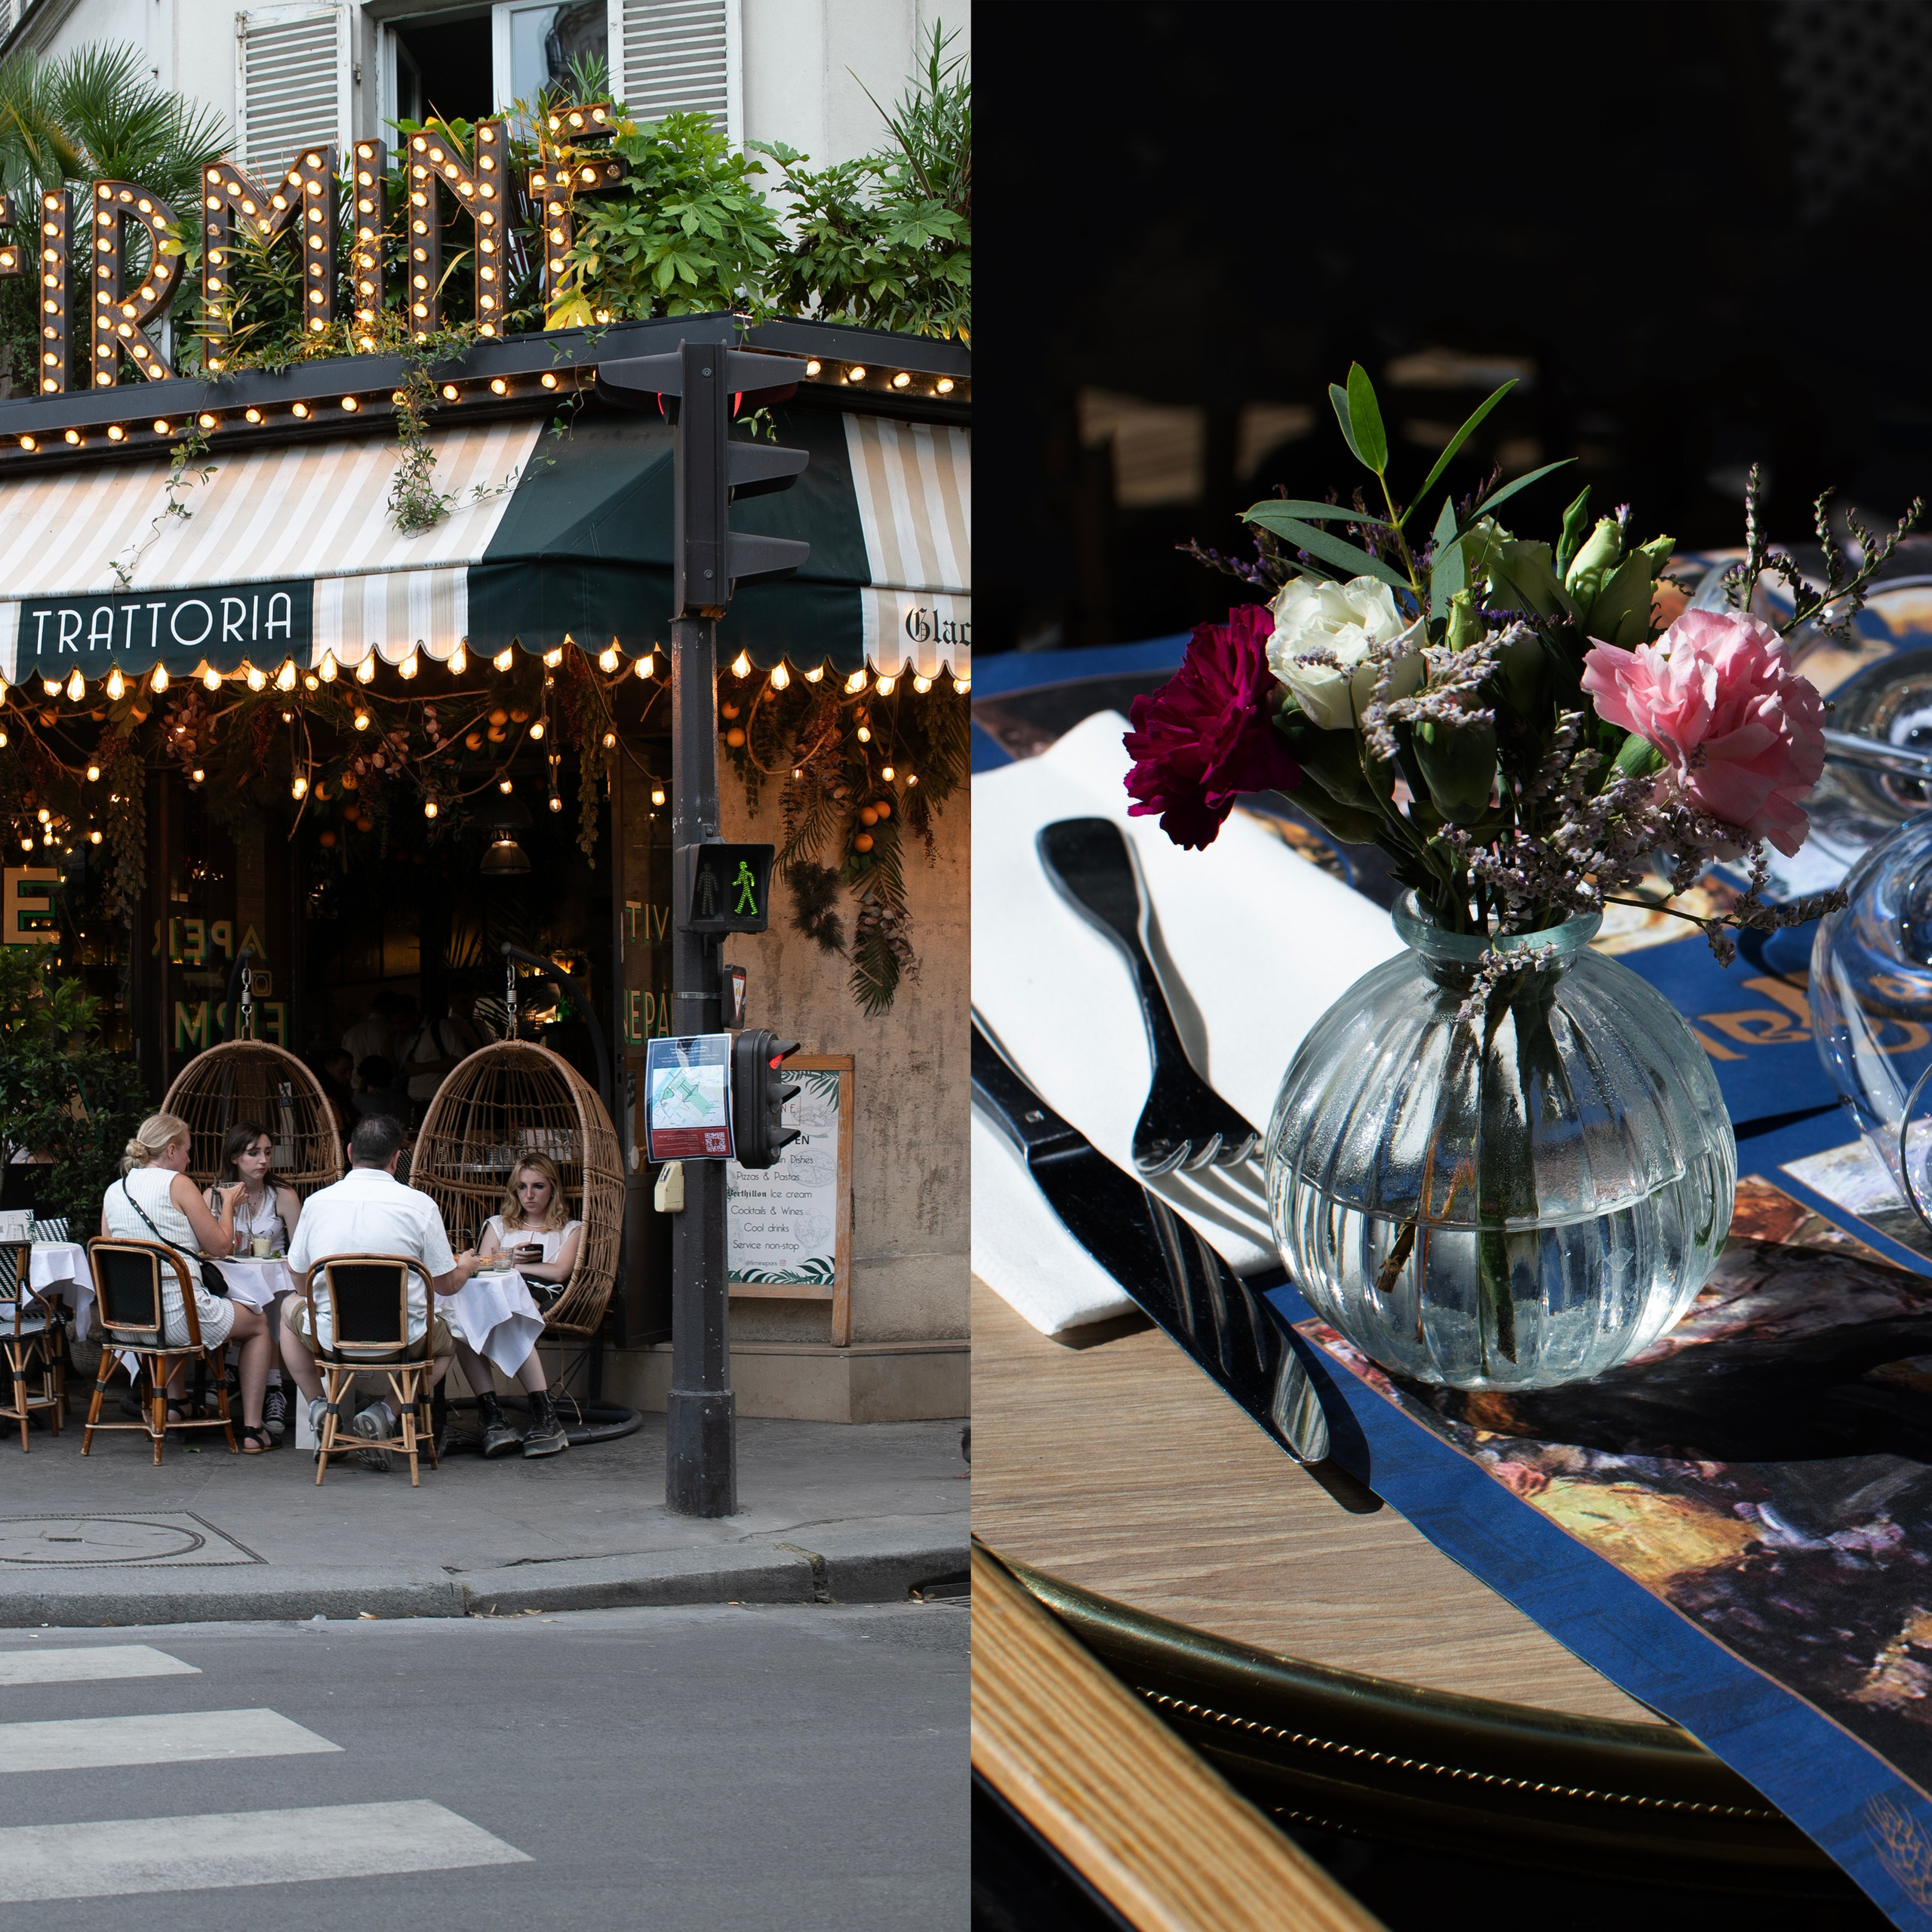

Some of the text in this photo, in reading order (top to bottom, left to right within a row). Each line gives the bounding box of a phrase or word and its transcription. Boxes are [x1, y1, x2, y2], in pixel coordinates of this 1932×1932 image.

[32, 592, 292, 655] TRATTORIA
[906, 608, 971, 647] Glac
[790, 1155, 814, 1164] Dishes
[737, 1171, 800, 1181] Pizzas & Pastas
[771, 1189, 782, 1198] Ice
[731, 1205, 804, 1216] Cocktails & Wines
[744, 1222, 789, 1232] Cool drinks
[733, 1239, 800, 1253] Service non-stop
